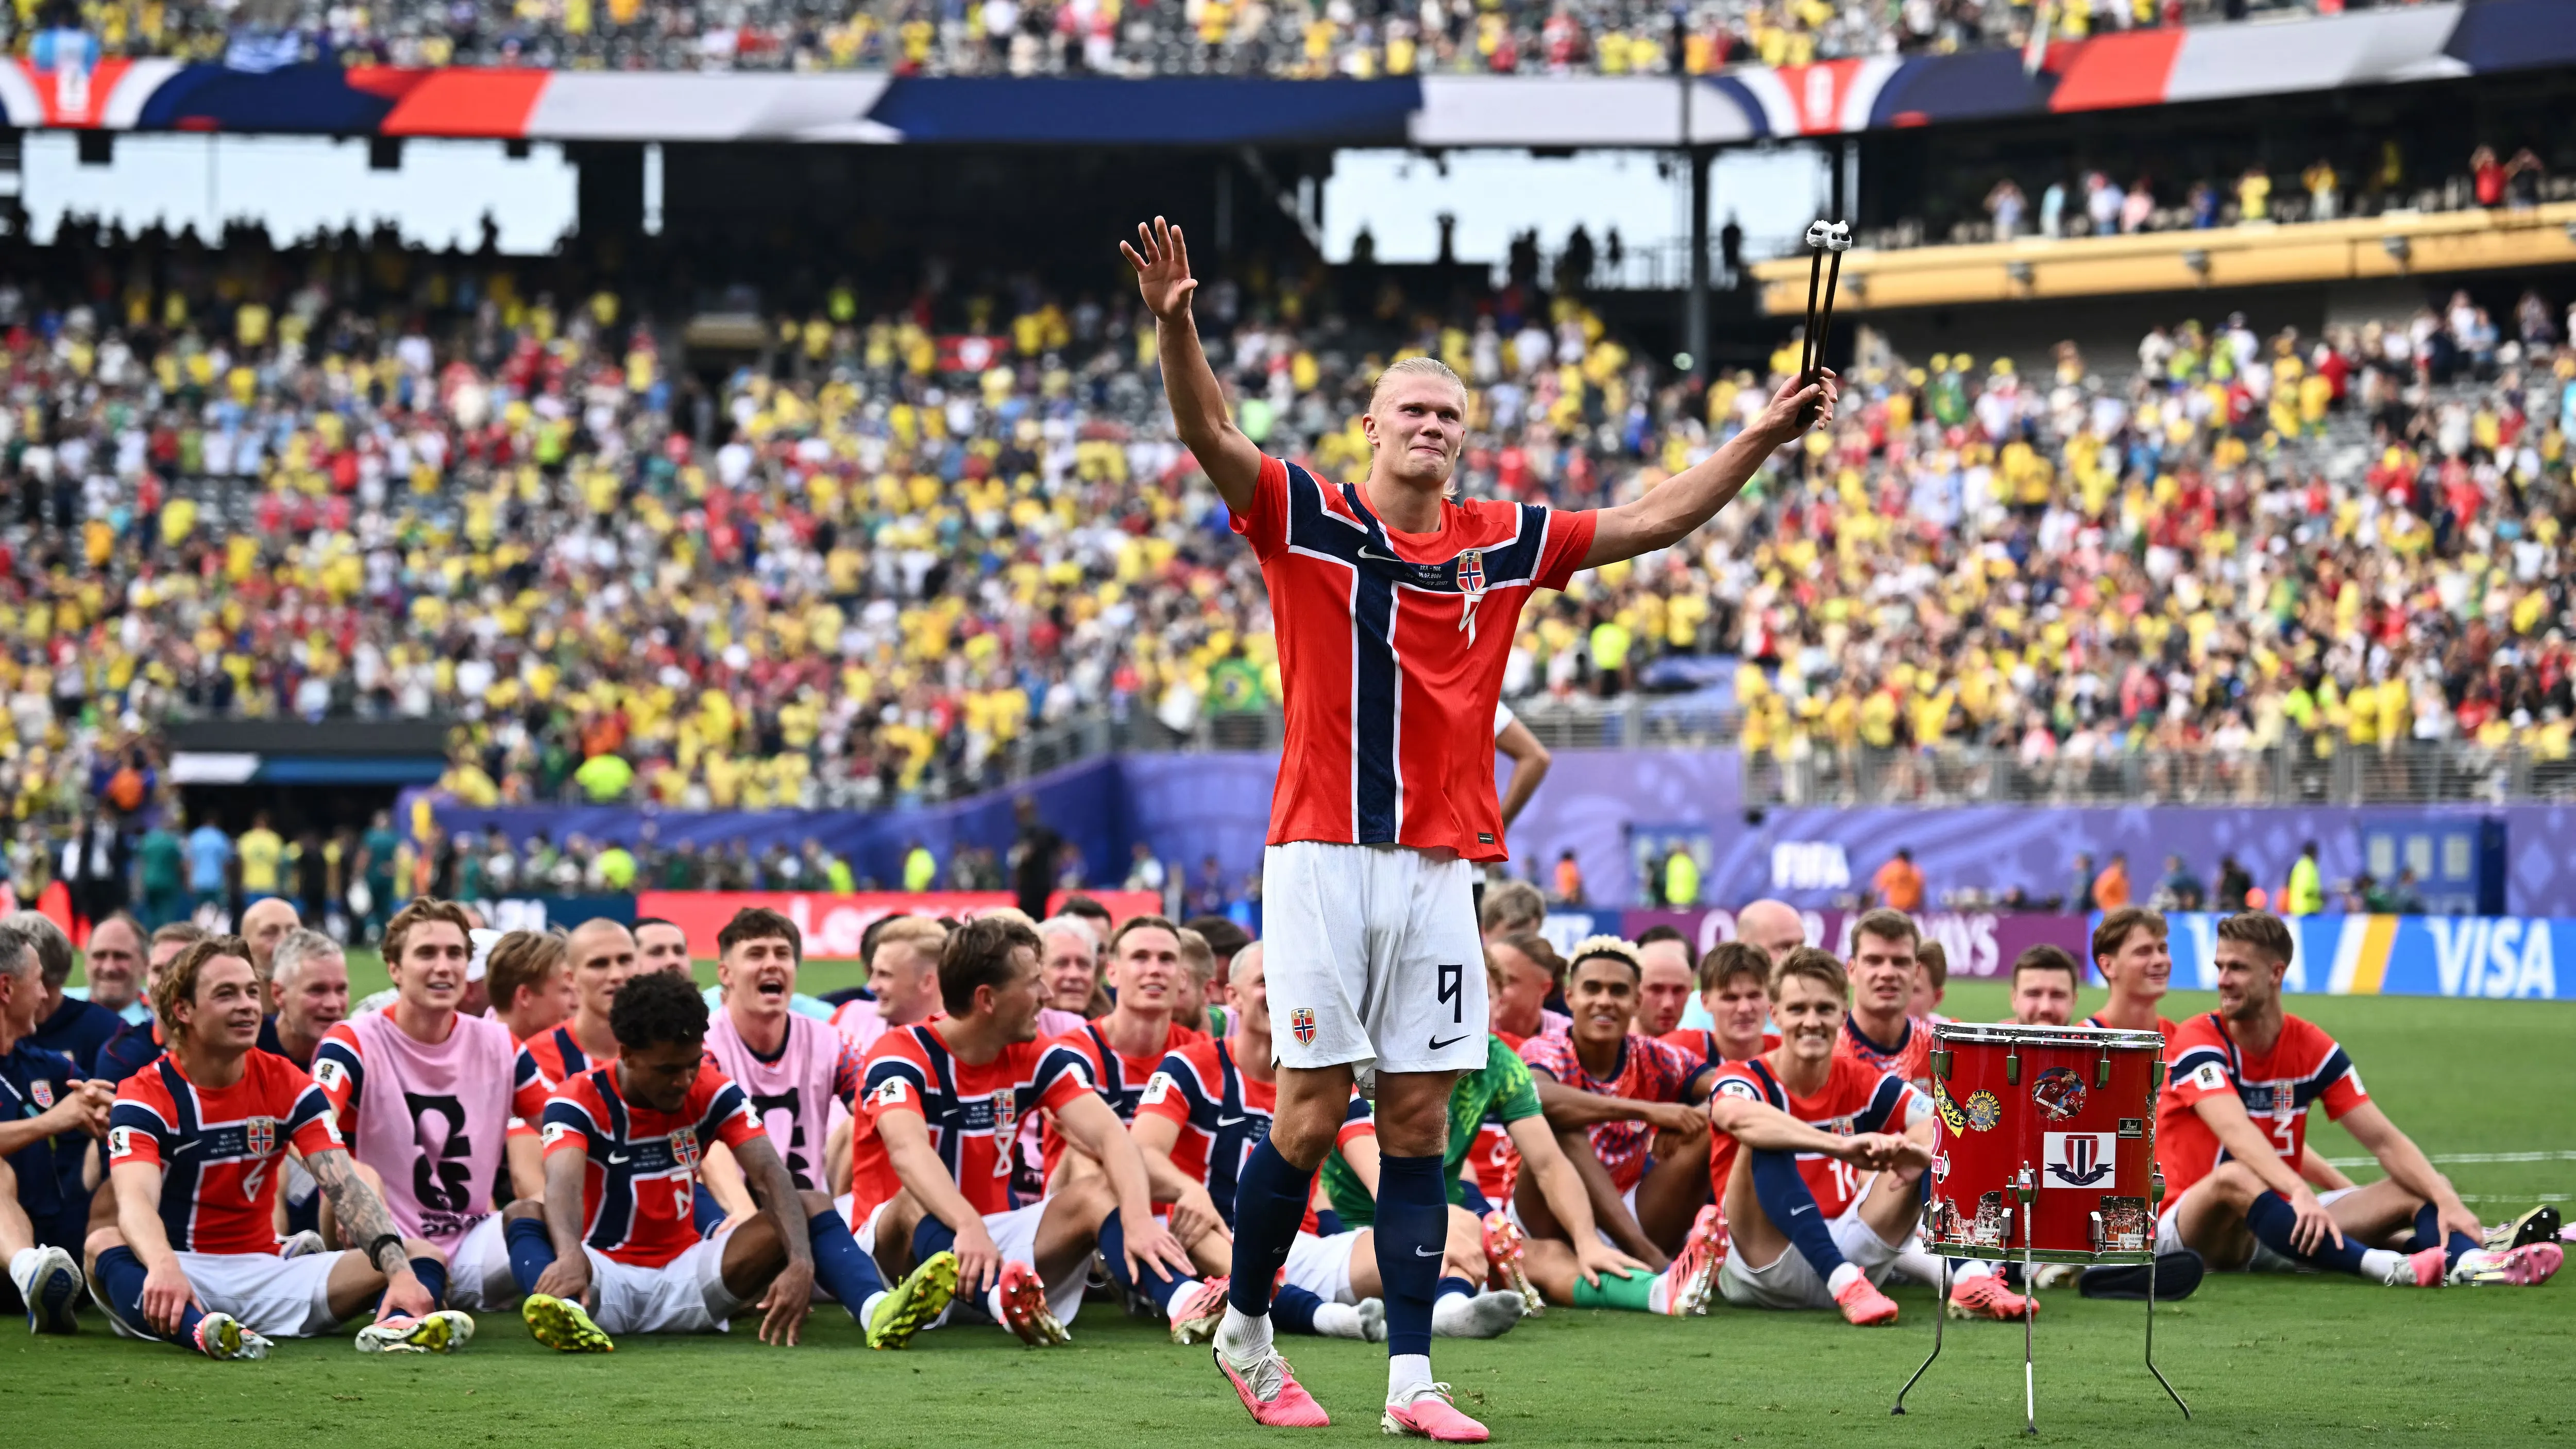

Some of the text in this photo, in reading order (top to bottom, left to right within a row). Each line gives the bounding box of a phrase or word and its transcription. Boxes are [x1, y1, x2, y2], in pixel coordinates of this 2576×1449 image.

[1458, 594, 1483, 650] 9
[1772, 841, 1851, 890] FIFA
[2425, 917, 2556, 999] VISA
[1437, 964, 1463, 1023] 9
[1967, 1091, 2001, 1116] SØRLANDETS
[2124, 1120, 2138, 1130] Pearl
[993, 1132, 1015, 1178] 8
[2273, 1115, 2294, 1157] 3
[243, 1159, 267, 1203] 6
